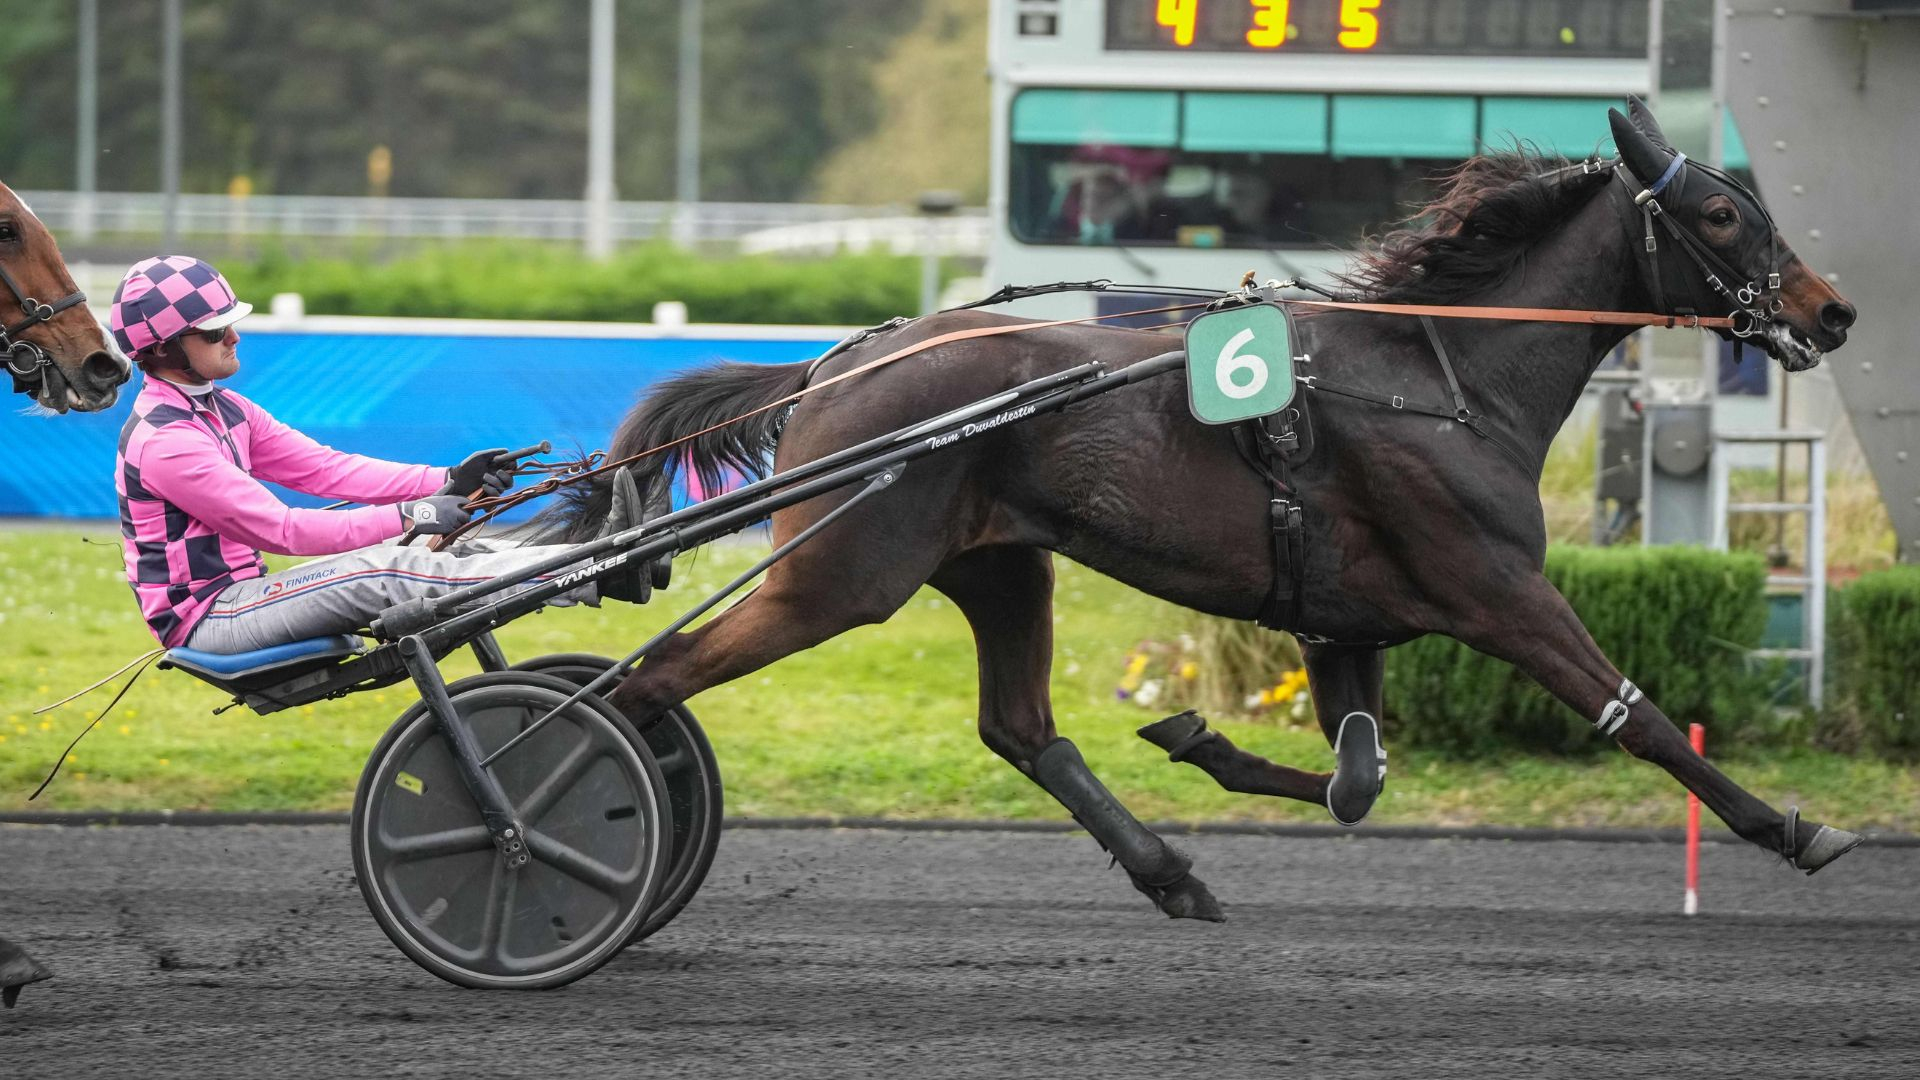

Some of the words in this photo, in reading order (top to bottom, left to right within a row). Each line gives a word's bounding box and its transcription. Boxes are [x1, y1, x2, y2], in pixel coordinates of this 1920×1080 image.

[1157, 0, 1197, 46] 4
[1247, 0, 1289, 47] 3
[1338, 0, 1382, 48] 5
[1215, 327, 1269, 399] 6
[925, 433, 960, 449] Team
[962, 405, 1036, 437] Duvaldestin
[285, 567, 337, 588] FINNTACK
[555, 552, 628, 588] YANKEE
